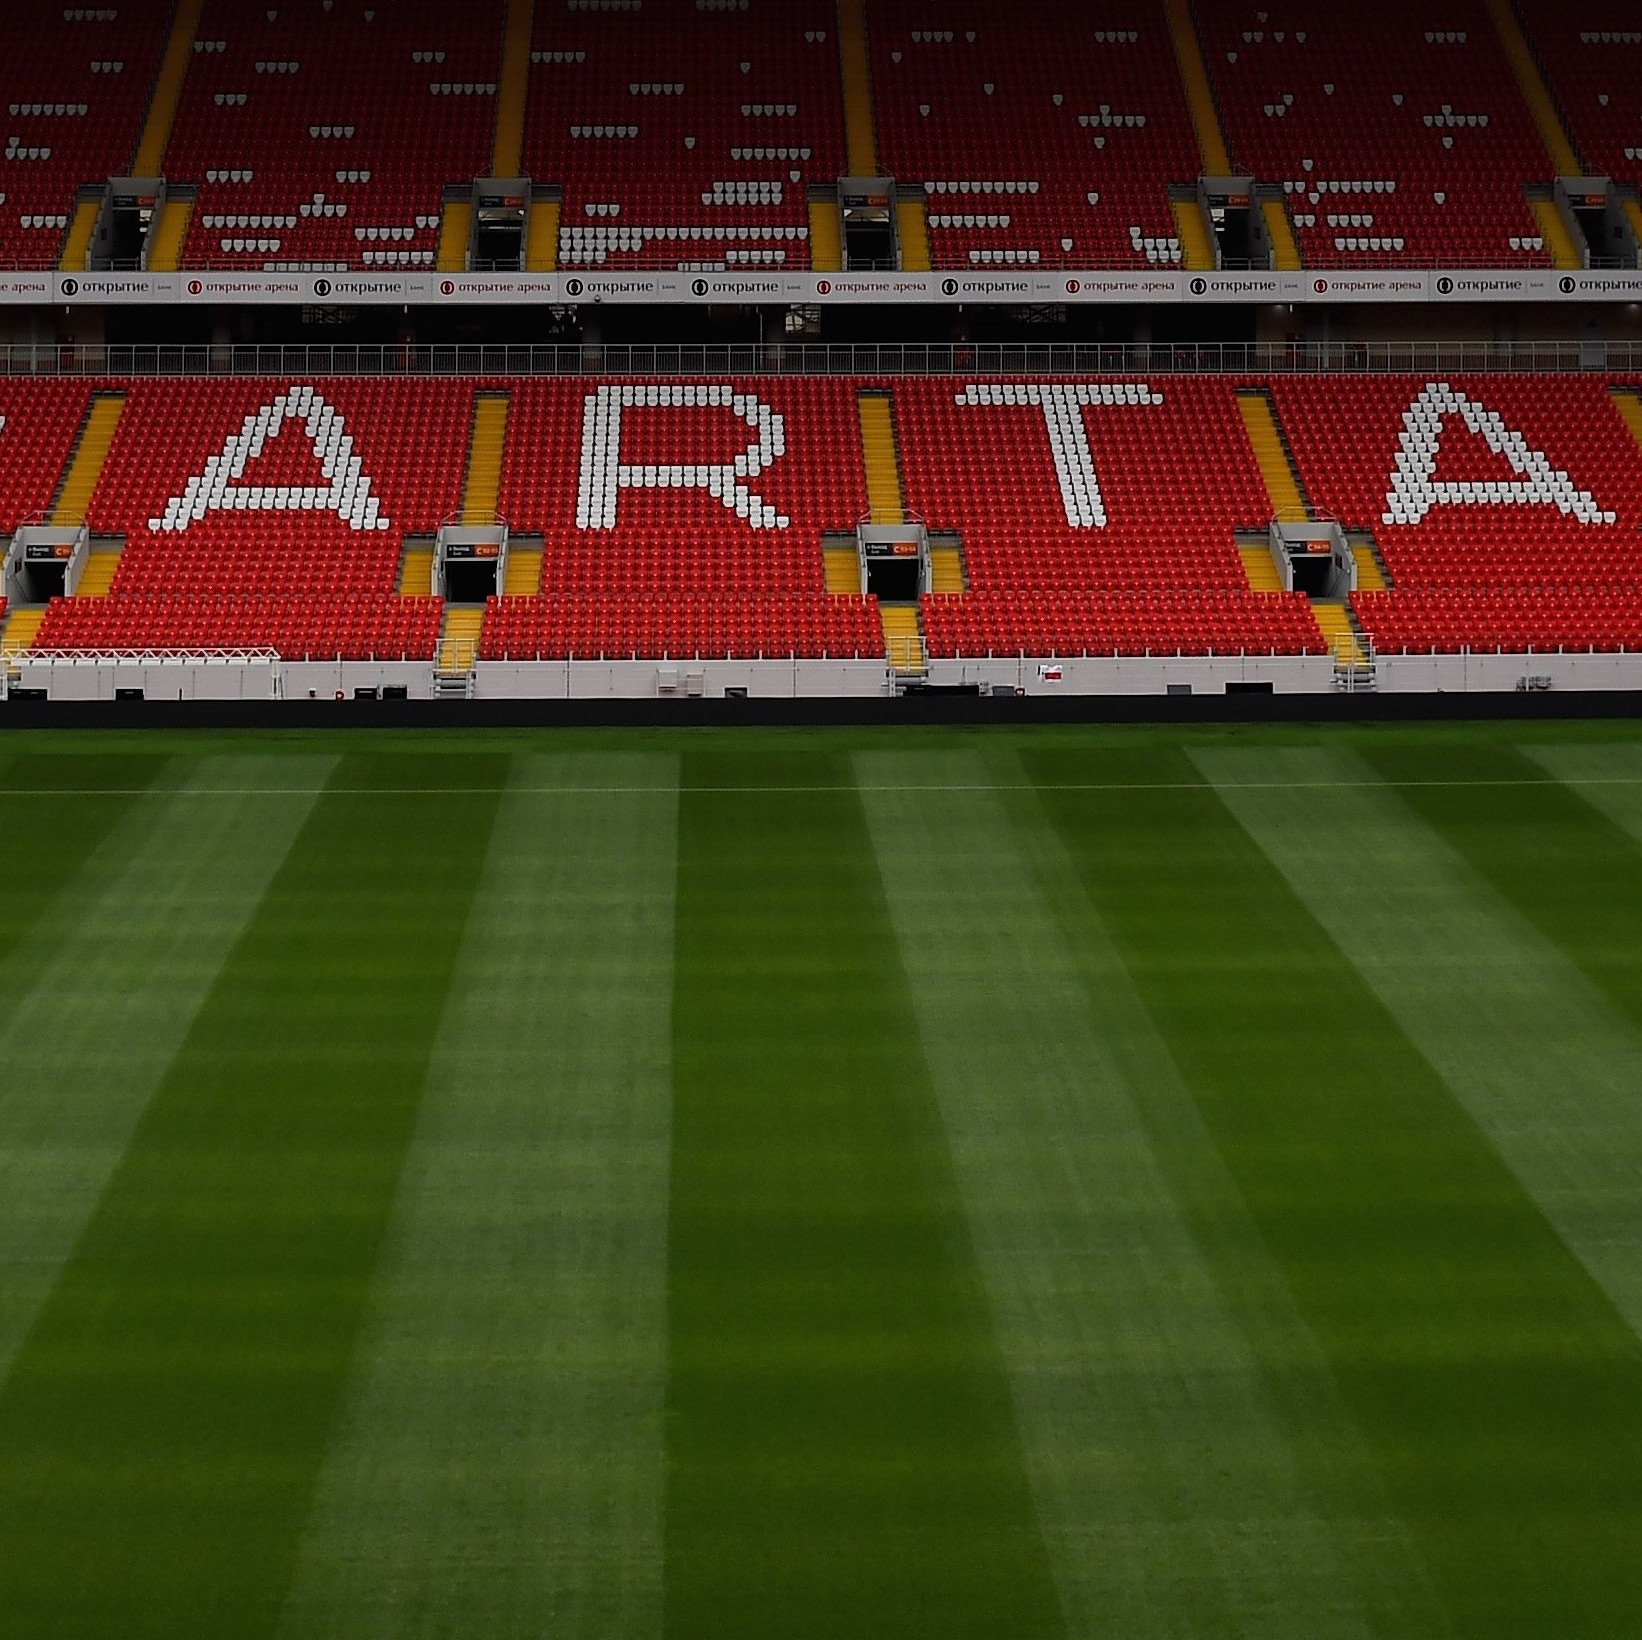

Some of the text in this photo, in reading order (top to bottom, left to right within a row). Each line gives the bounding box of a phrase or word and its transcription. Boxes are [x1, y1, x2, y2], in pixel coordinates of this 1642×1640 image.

[11, 283, 46, 294] арена
[82, 282, 149, 295] открытие
[206, 283, 299, 294] открытие арена
[335, 283, 402, 296] открытие
[458, 284, 551, 295] открытие арена
[587, 282, 654, 295] открытие
[712, 282, 779, 296] открытие
[834, 283, 927, 294] открытие арена
[962, 282, 1029, 295] открытие
[1083, 282, 1175, 293] открытие арена
[1210, 281, 1276, 294] открытие
[1331, 282, 1422, 292] открытие арена
[1457, 280, 1522, 293] открытие
